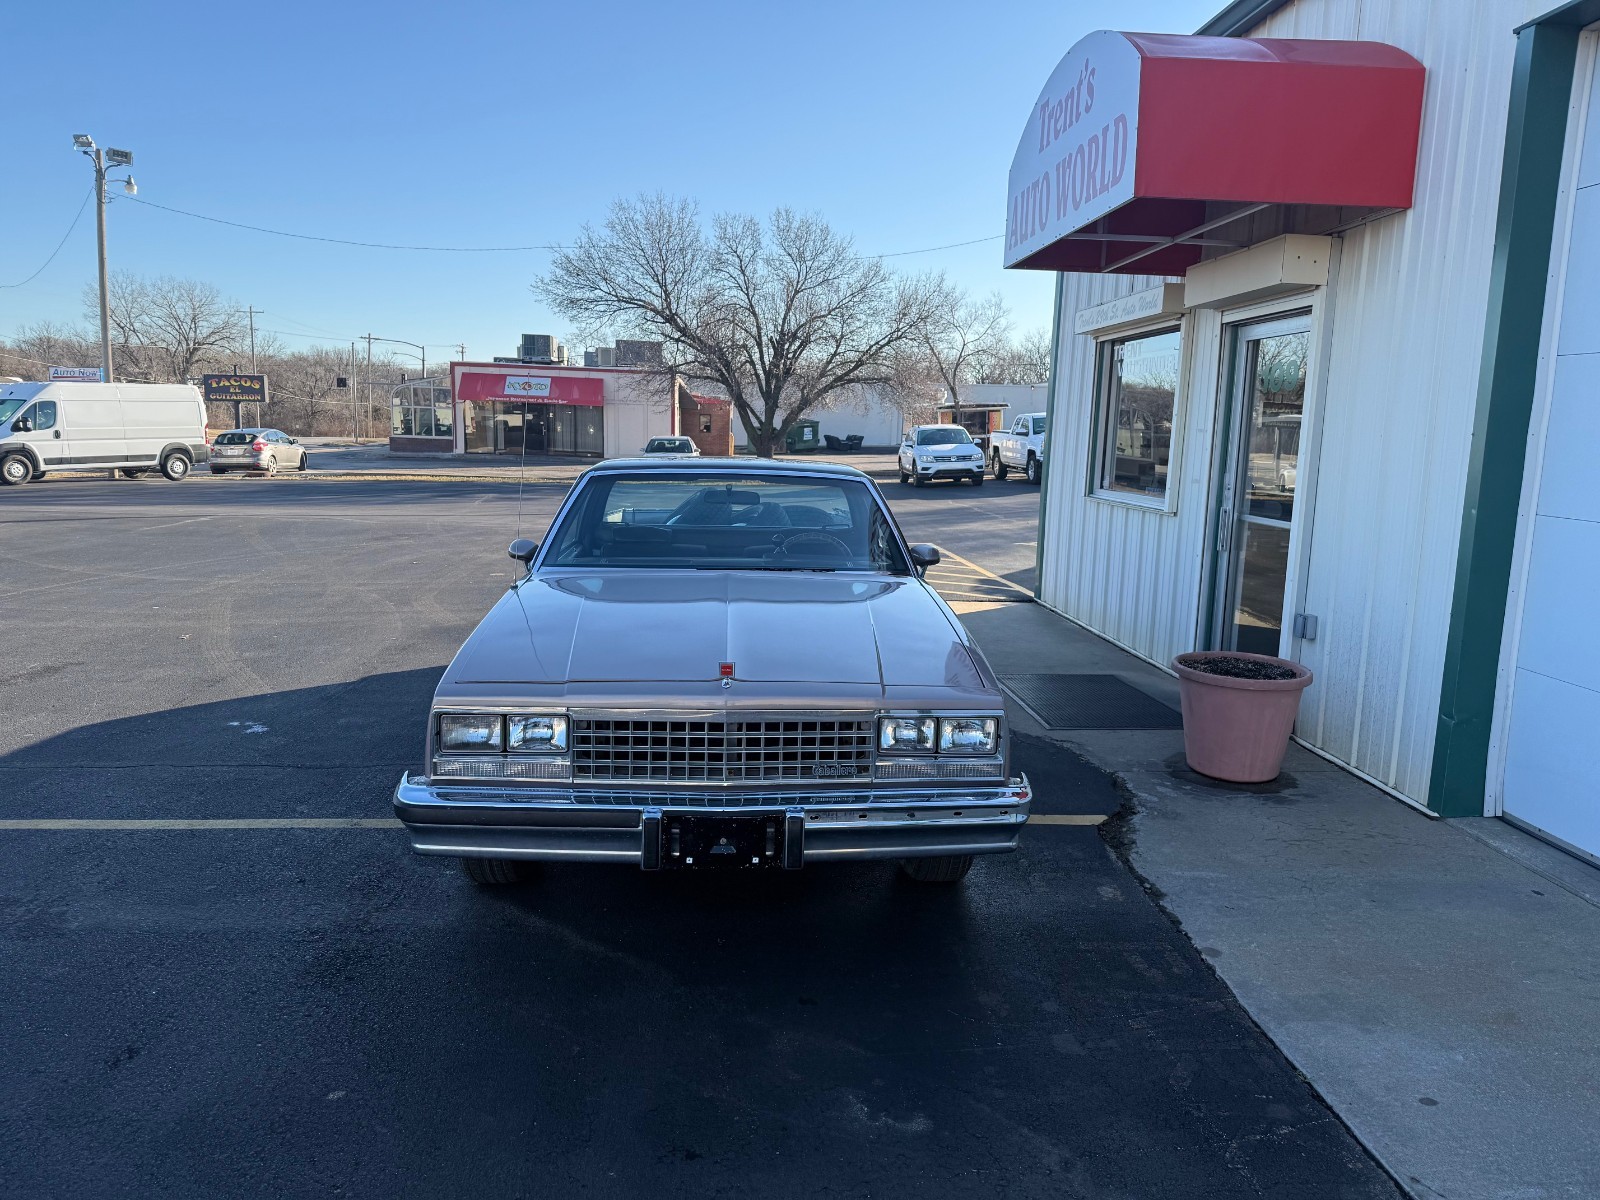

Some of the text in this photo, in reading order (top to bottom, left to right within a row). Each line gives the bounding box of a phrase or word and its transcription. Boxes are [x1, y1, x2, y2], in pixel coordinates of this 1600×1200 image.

[1038, 57, 1096, 154] Trent's
[1008, 113, 1128, 251] AUTO WORLD
[208, 377, 261, 389] TACOS
